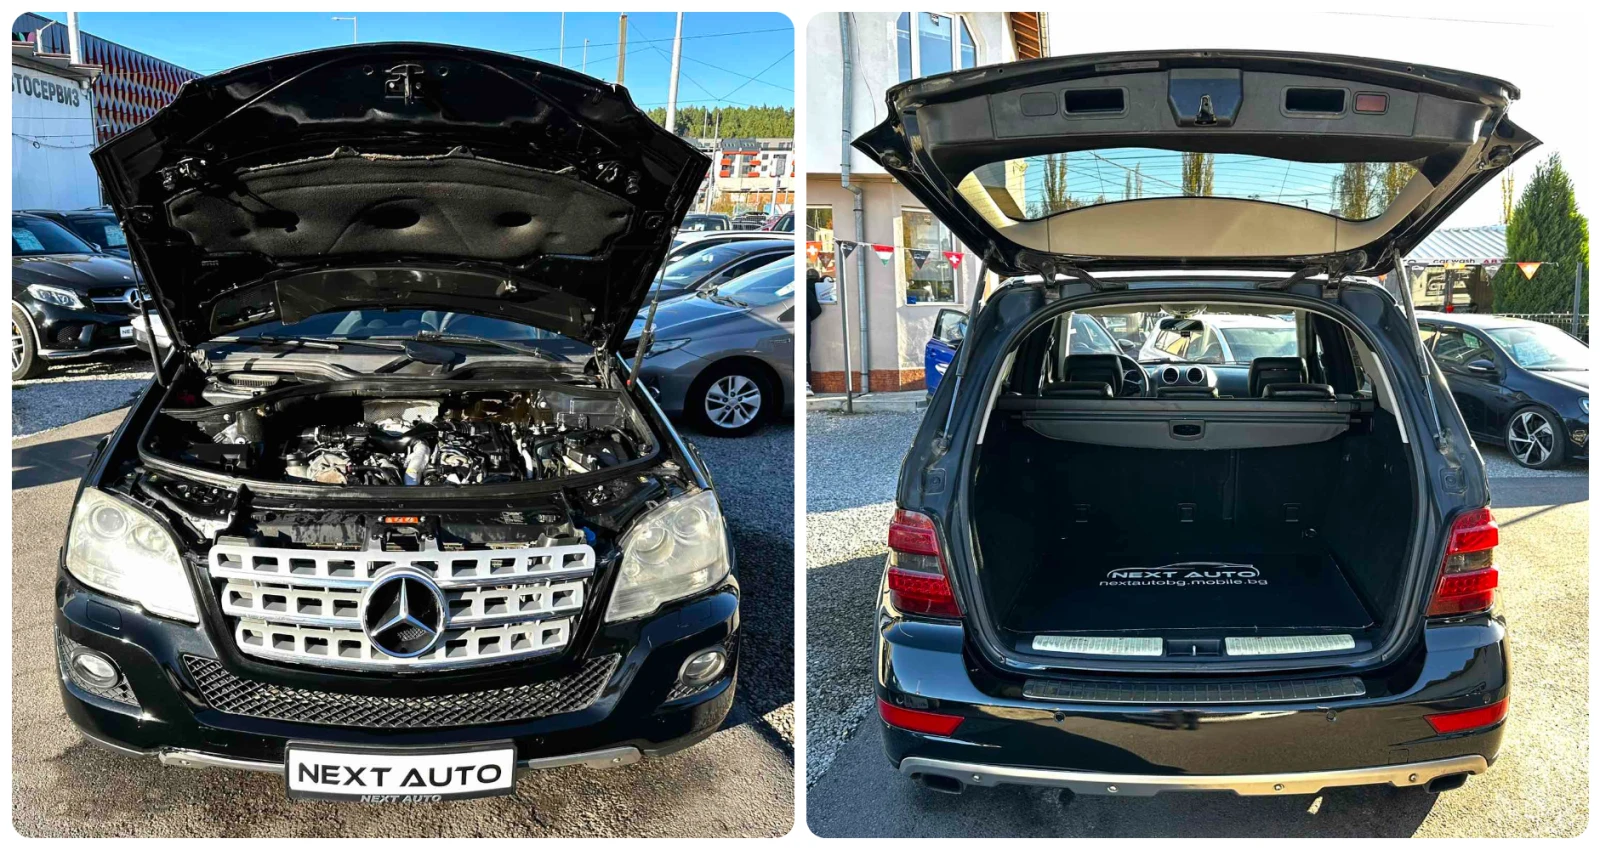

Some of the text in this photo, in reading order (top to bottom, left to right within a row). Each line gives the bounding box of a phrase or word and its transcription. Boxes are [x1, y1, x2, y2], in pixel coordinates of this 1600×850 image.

[1111, 571, 1256, 579] NEXT AUTO
[1099, 578, 1268, 587] nextautobg.mobile.bg
[298, 762, 502, 787] NEXT AUTO
[360, 794, 442, 803] NEXT AUTO
